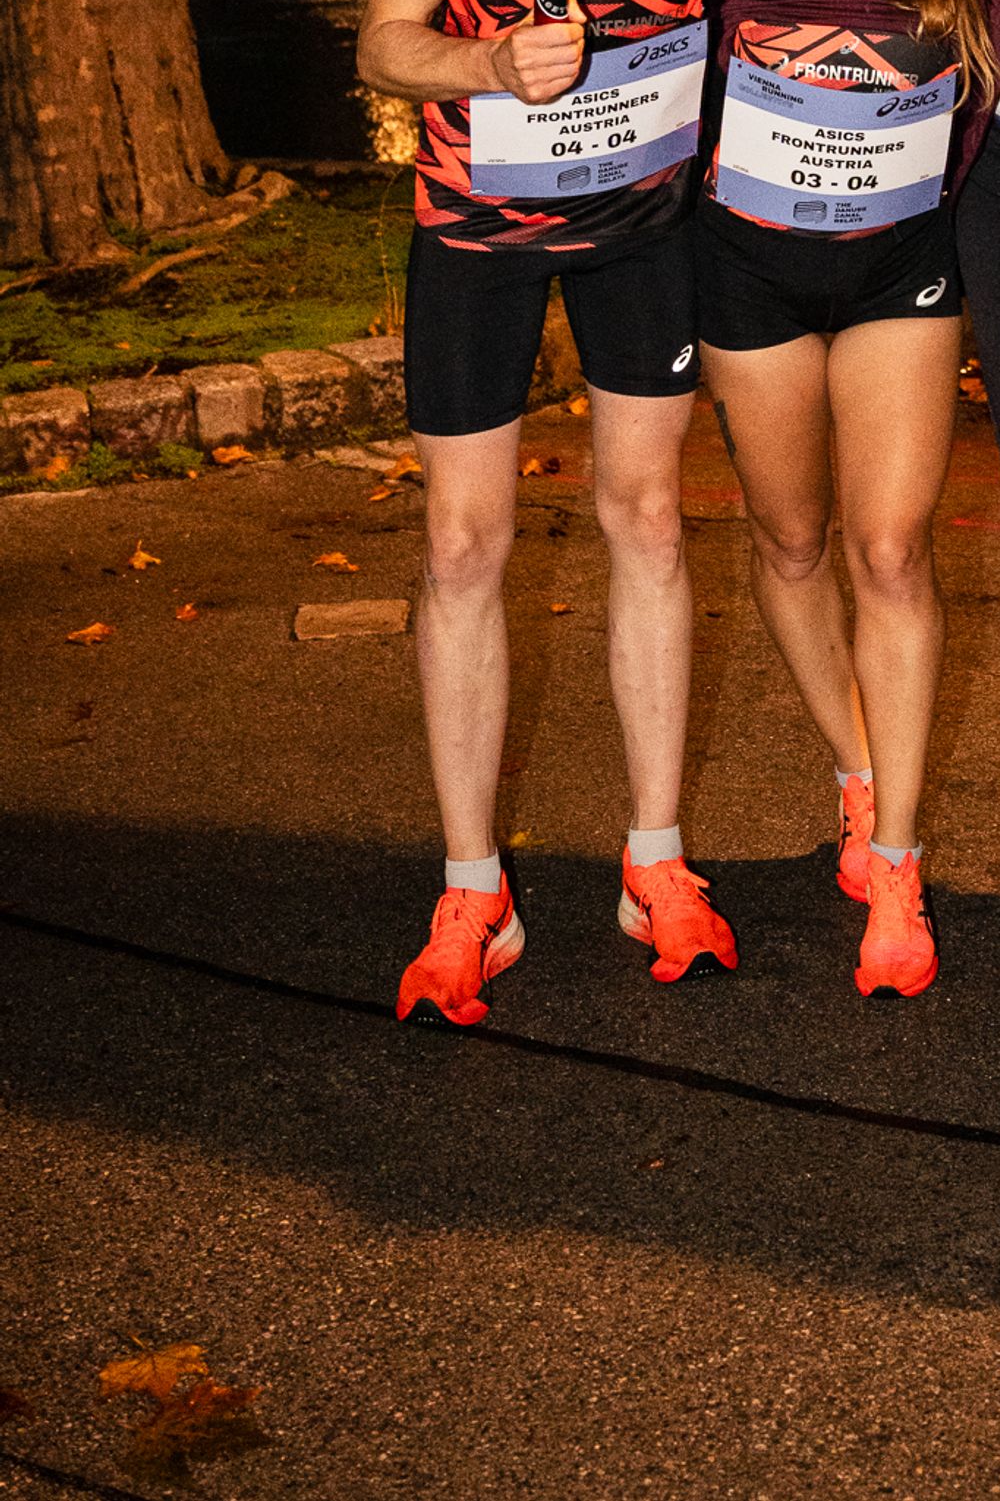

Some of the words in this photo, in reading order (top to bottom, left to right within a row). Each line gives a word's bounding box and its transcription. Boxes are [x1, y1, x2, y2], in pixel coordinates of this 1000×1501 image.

[748, 72, 781, 91] VIENNA
[795, 62, 919, 88] FRONTRUNNER
[572, 88, 620, 106] ASICS
[762, 86, 804, 105] RUNNING
[527, 91, 660, 124] FRONTRUNNERS
[559, 115, 630, 136] AUSTRIA
[814, 128, 865, 142] ASICS
[551, 140, 584, 157] 04
[607, 129, 637, 149] 04
[771, 130, 906, 155] FRONTRUNNERS
[800, 154, 873, 170] AUSTRIA
[790, 169, 822, 188] 03
[847, 174, 879, 191] 04
